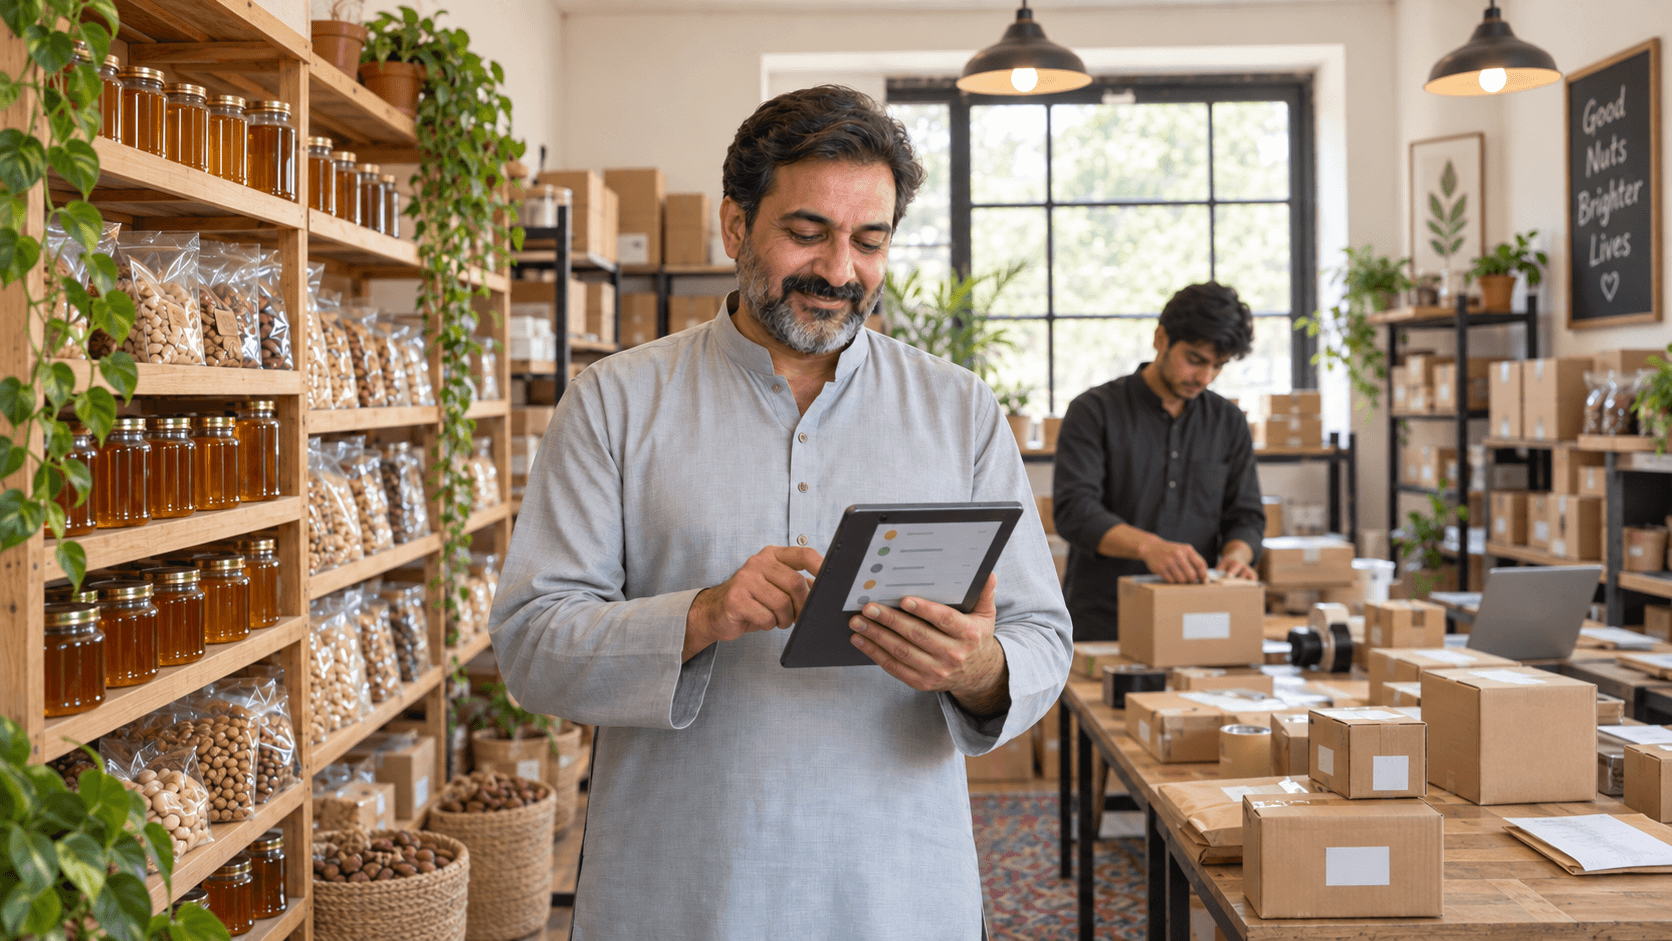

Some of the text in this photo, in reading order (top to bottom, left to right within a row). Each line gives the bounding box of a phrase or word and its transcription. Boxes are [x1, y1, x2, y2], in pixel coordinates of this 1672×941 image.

[1583, 85, 1626, 135] Good
[1586, 135, 1627, 178] Nuts
[1578, 178, 1643, 227] Brighter
[1589, 232, 1631, 267] Lives
